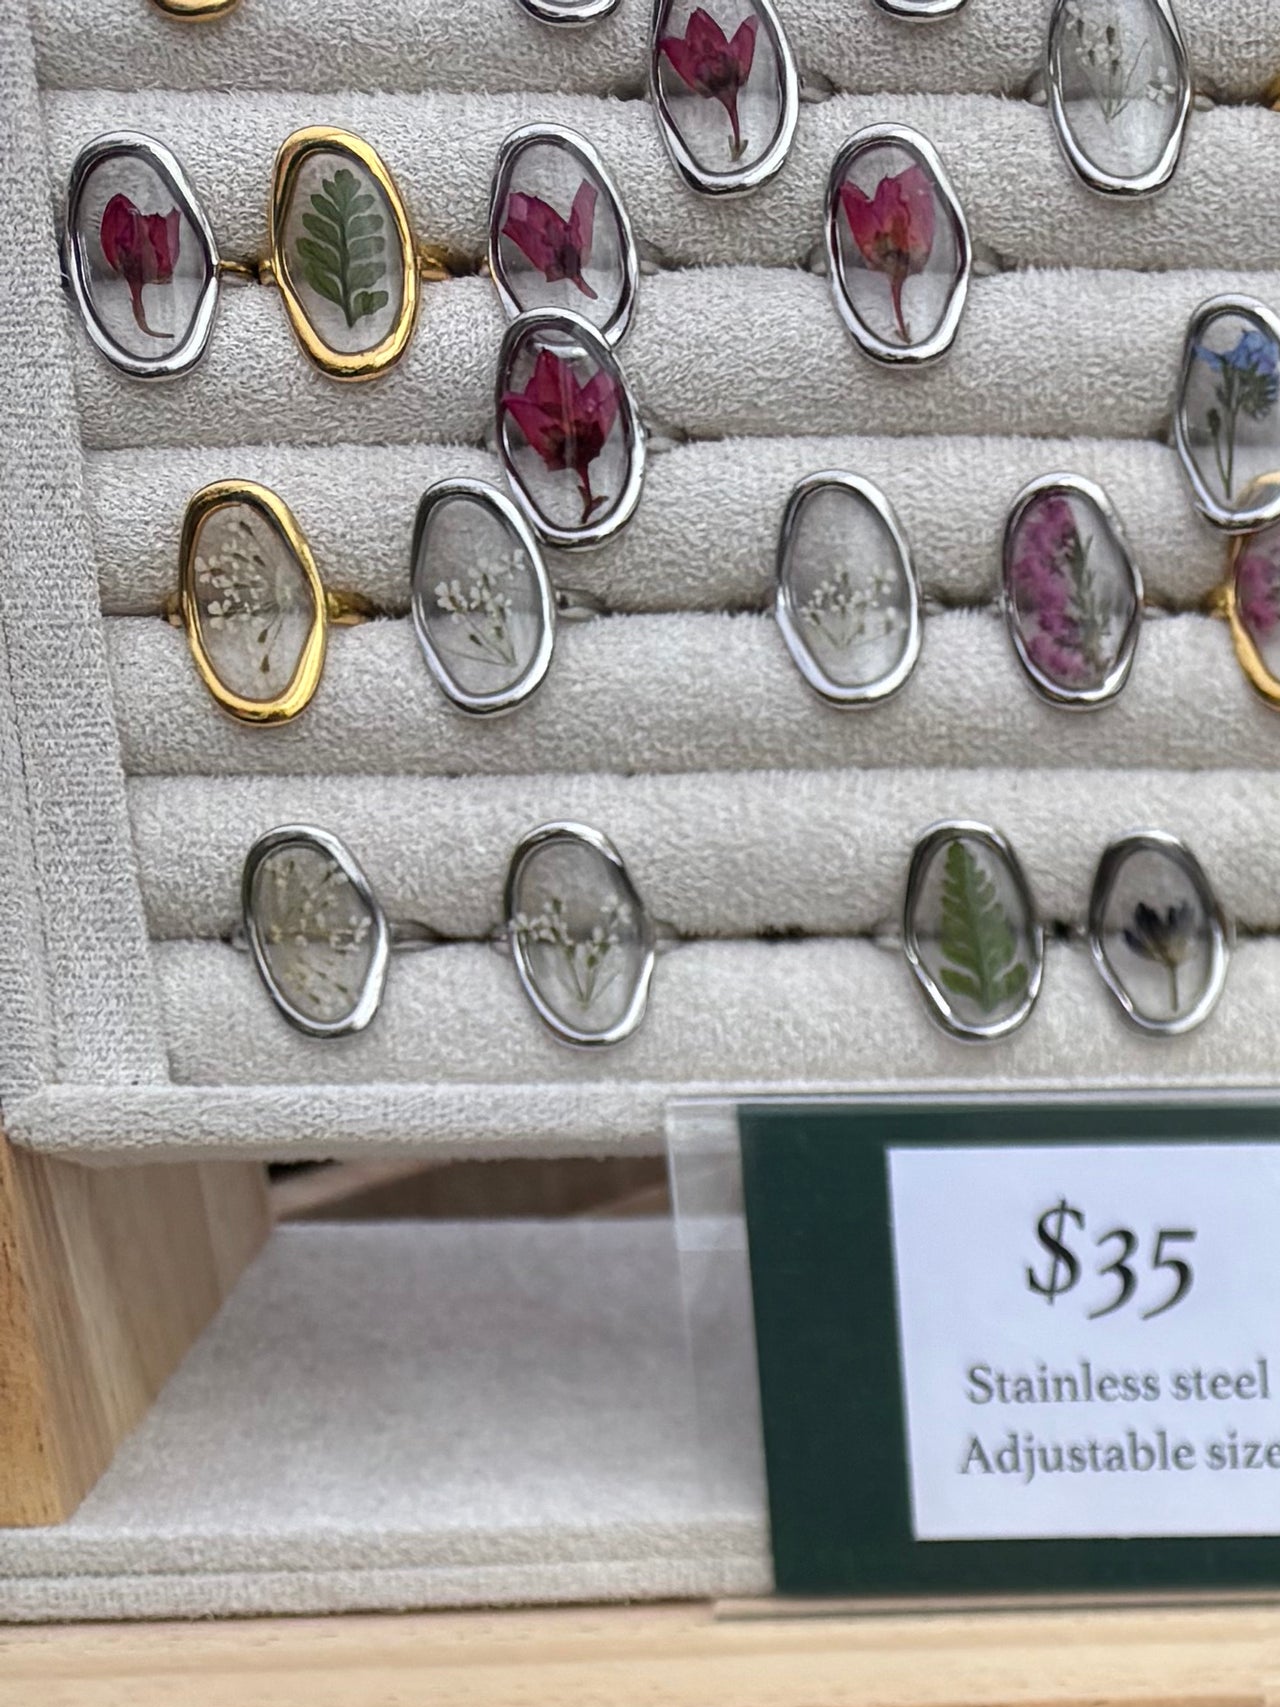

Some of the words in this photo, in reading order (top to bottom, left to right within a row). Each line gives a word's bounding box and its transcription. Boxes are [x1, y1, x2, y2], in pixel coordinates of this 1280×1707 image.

[1026, 1193, 1198, 1321] $35
[966, 1361, 1161, 1404] Stainless
[1171, 1356, 1271, 1401] steel
[958, 1428, 1196, 1484] Adjustable
